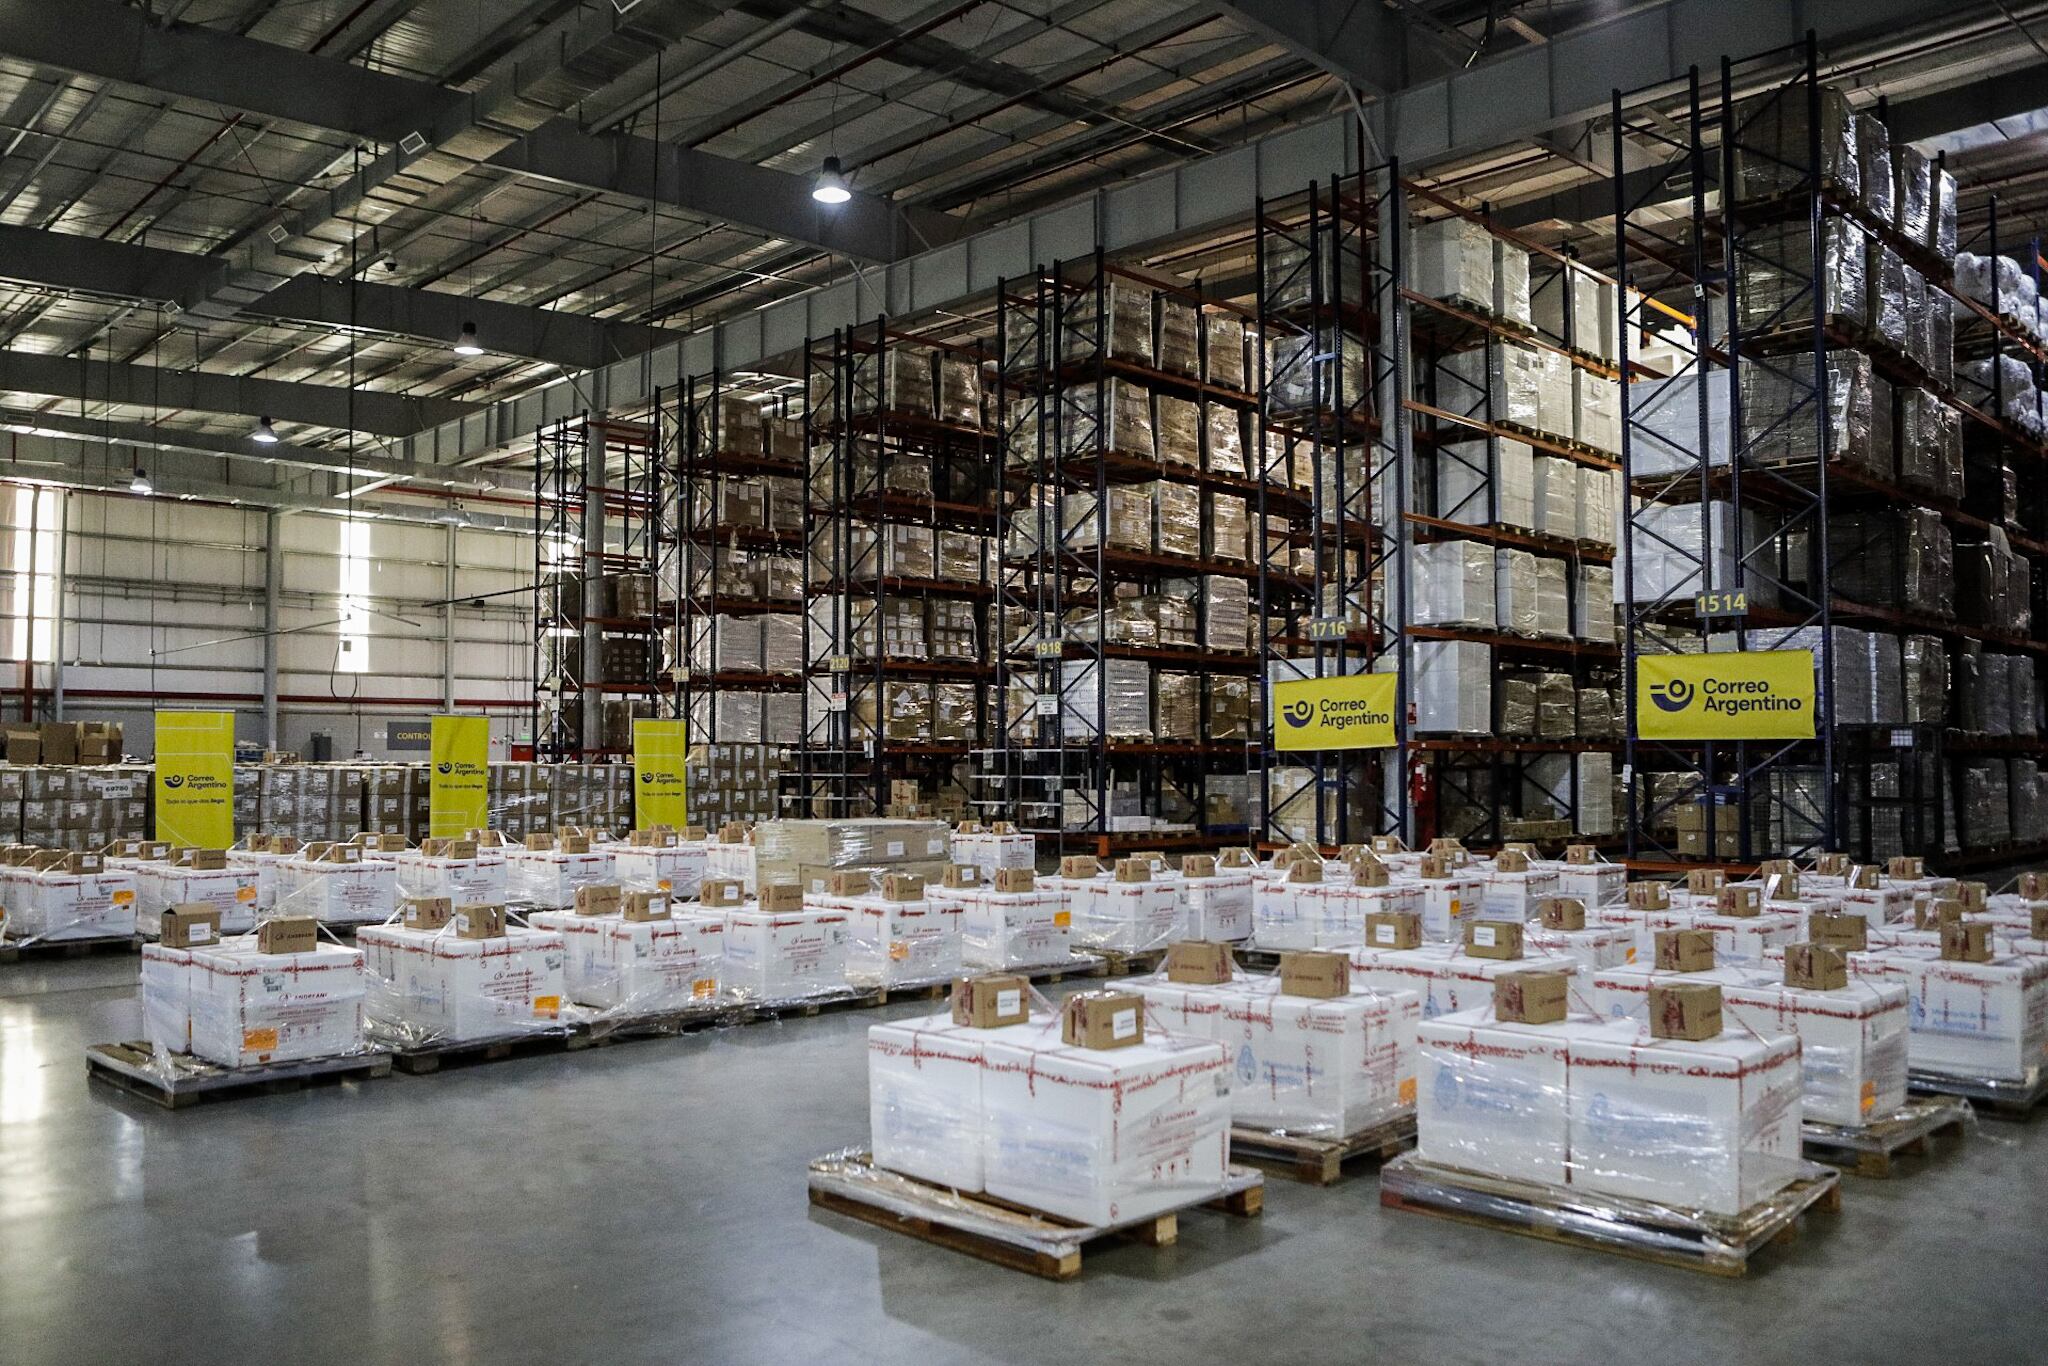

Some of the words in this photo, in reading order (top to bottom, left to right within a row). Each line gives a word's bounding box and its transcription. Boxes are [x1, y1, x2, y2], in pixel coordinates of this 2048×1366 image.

[1702, 677, 1769, 694] Correo
[1319, 698, 1366, 712] Correo
[1703, 694, 1802, 716] Argentino
[1320, 710, 1389, 730] Argentino
[187, 774, 215, 782] Correo
[455, 768, 484, 776] Argentino
[187, 781, 227, 790] Argentino
